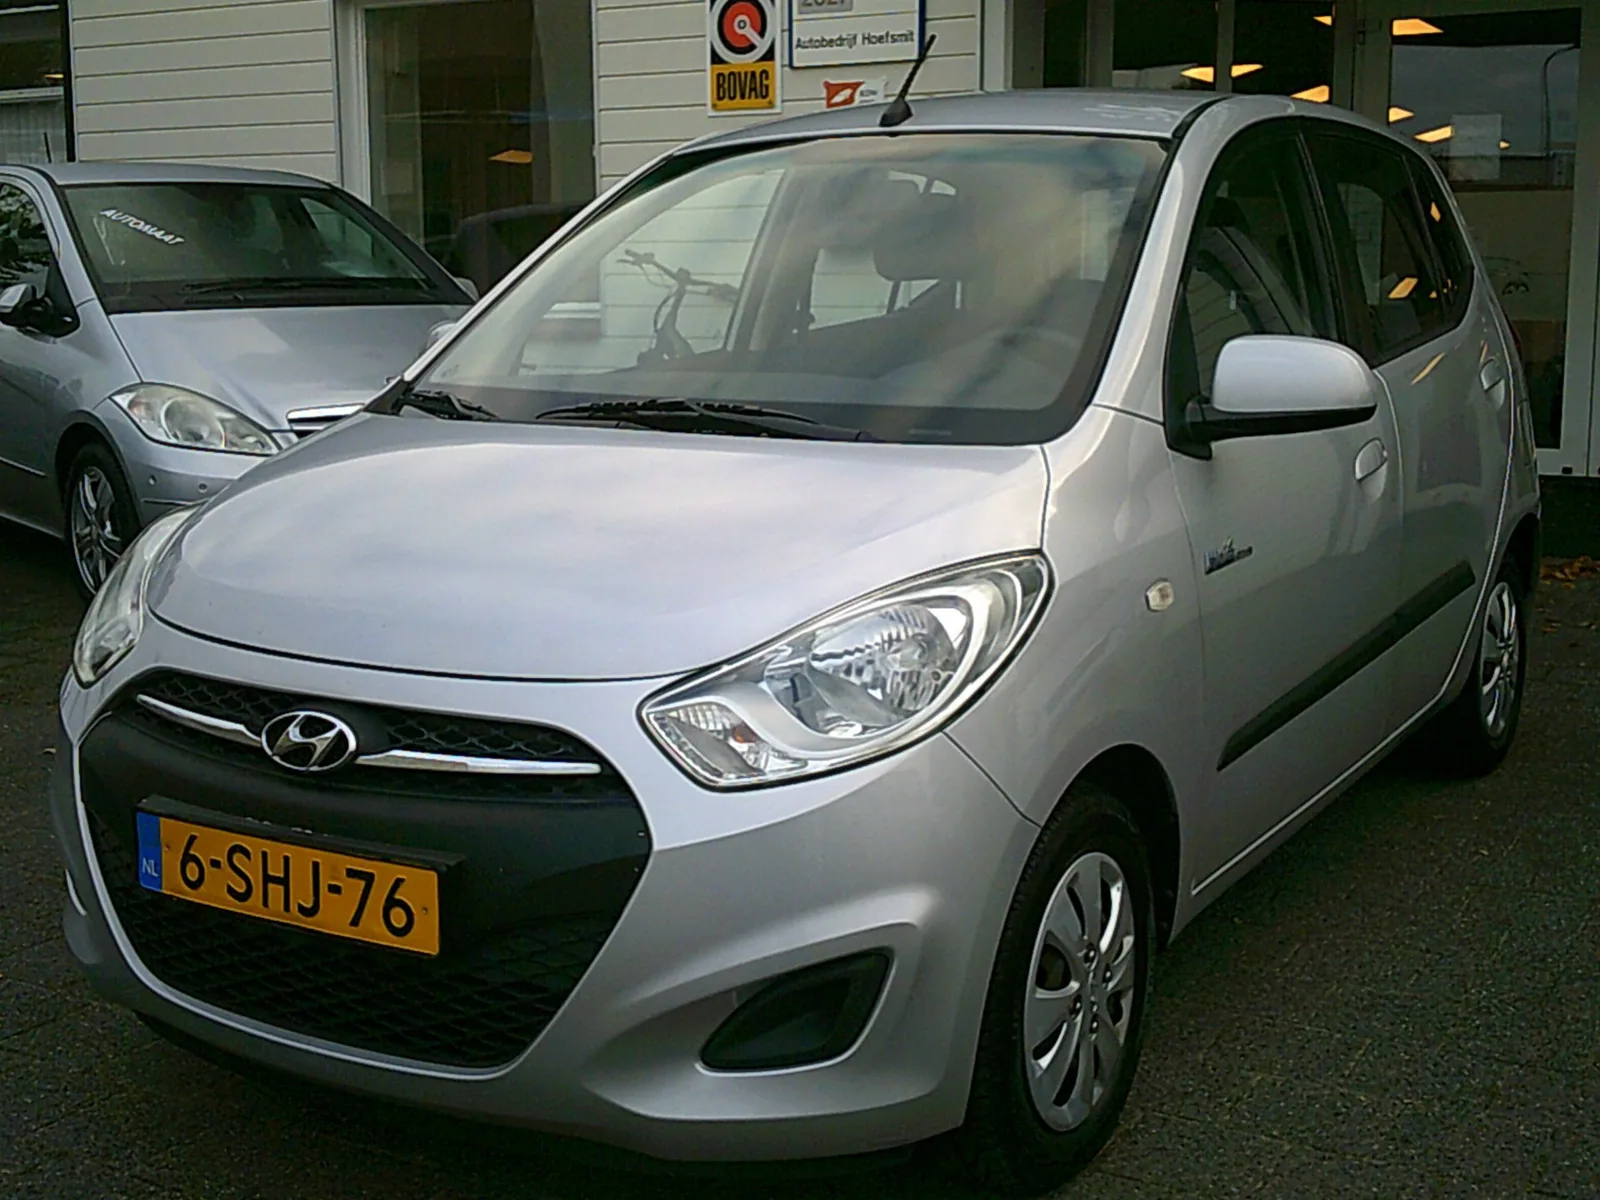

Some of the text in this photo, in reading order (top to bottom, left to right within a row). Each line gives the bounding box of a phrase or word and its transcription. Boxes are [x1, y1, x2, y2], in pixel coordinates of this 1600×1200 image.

[795, 29, 914, 49] Autobedrijf Hoefsmit
[715, 69, 770, 101] BOVAG
[99, 208, 185, 245] AUTOMAAT
[141, 856, 159, 877] NL
[178, 833, 416, 938] 6-SHJ-76
